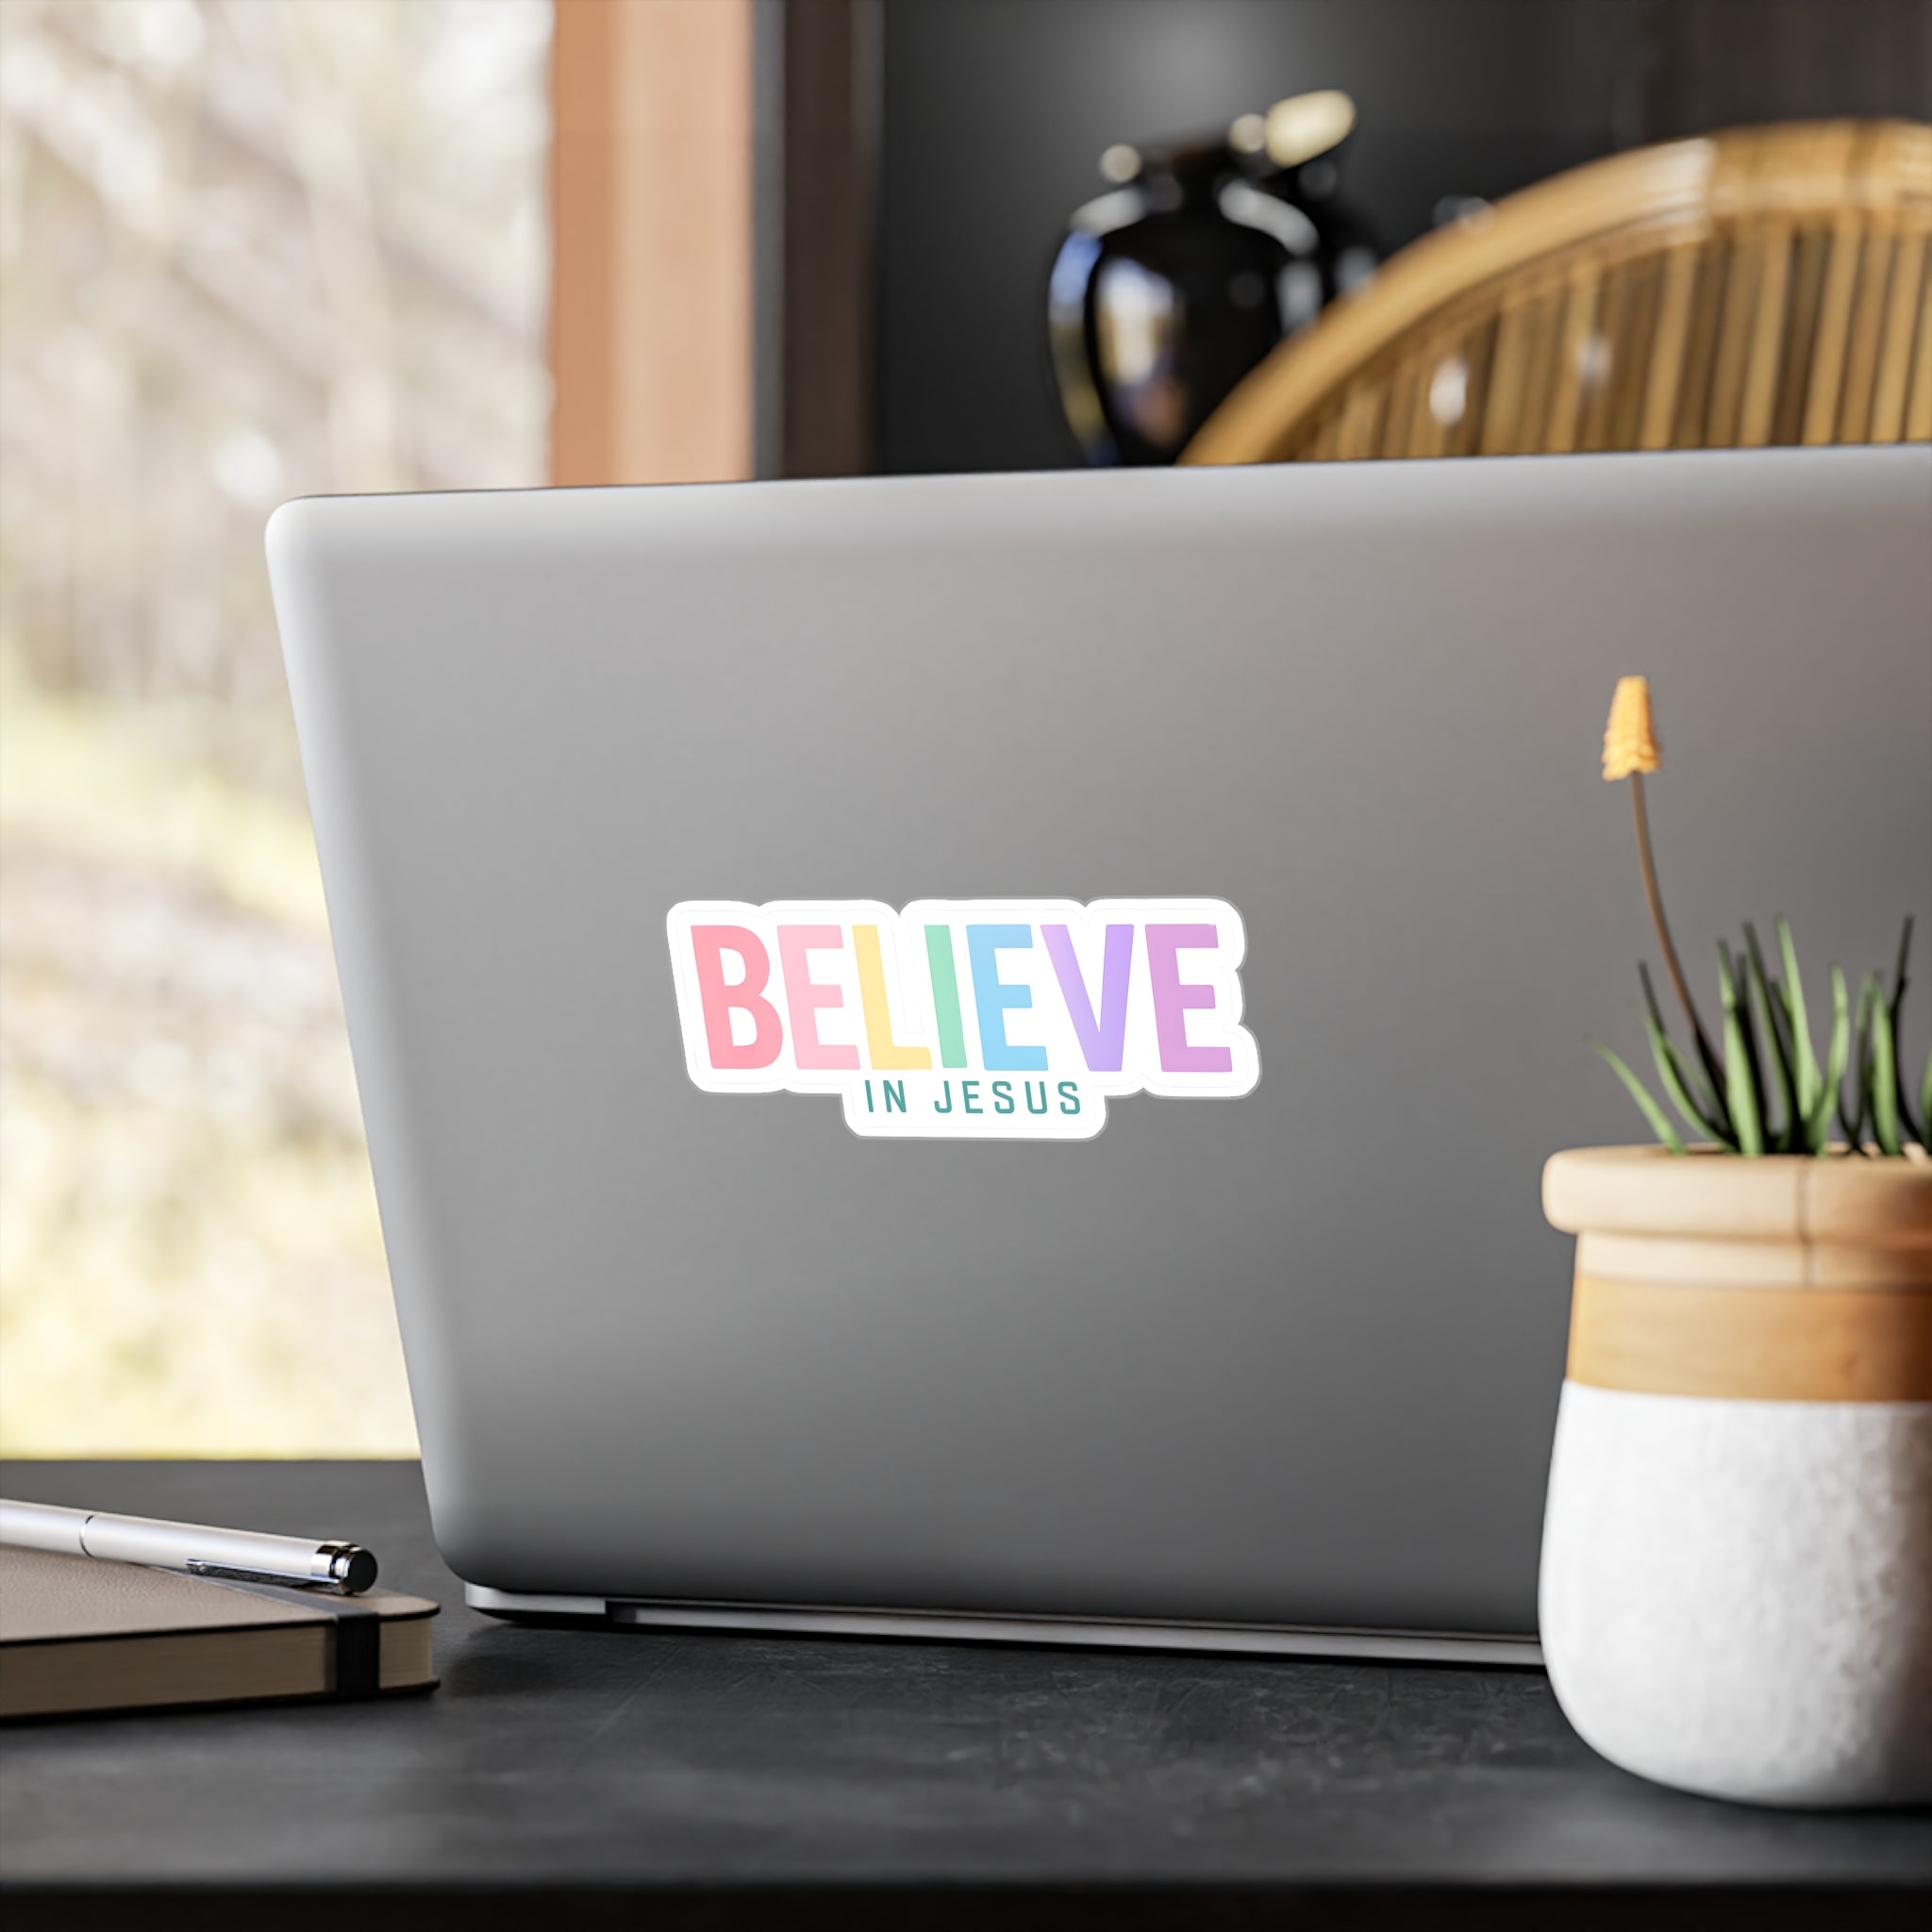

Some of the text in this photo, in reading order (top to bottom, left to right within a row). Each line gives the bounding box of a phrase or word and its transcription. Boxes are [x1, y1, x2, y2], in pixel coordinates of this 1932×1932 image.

[691, 924, 1233, 1073] BELIEVE
[864, 1079, 1081, 1115] IN JESUS
